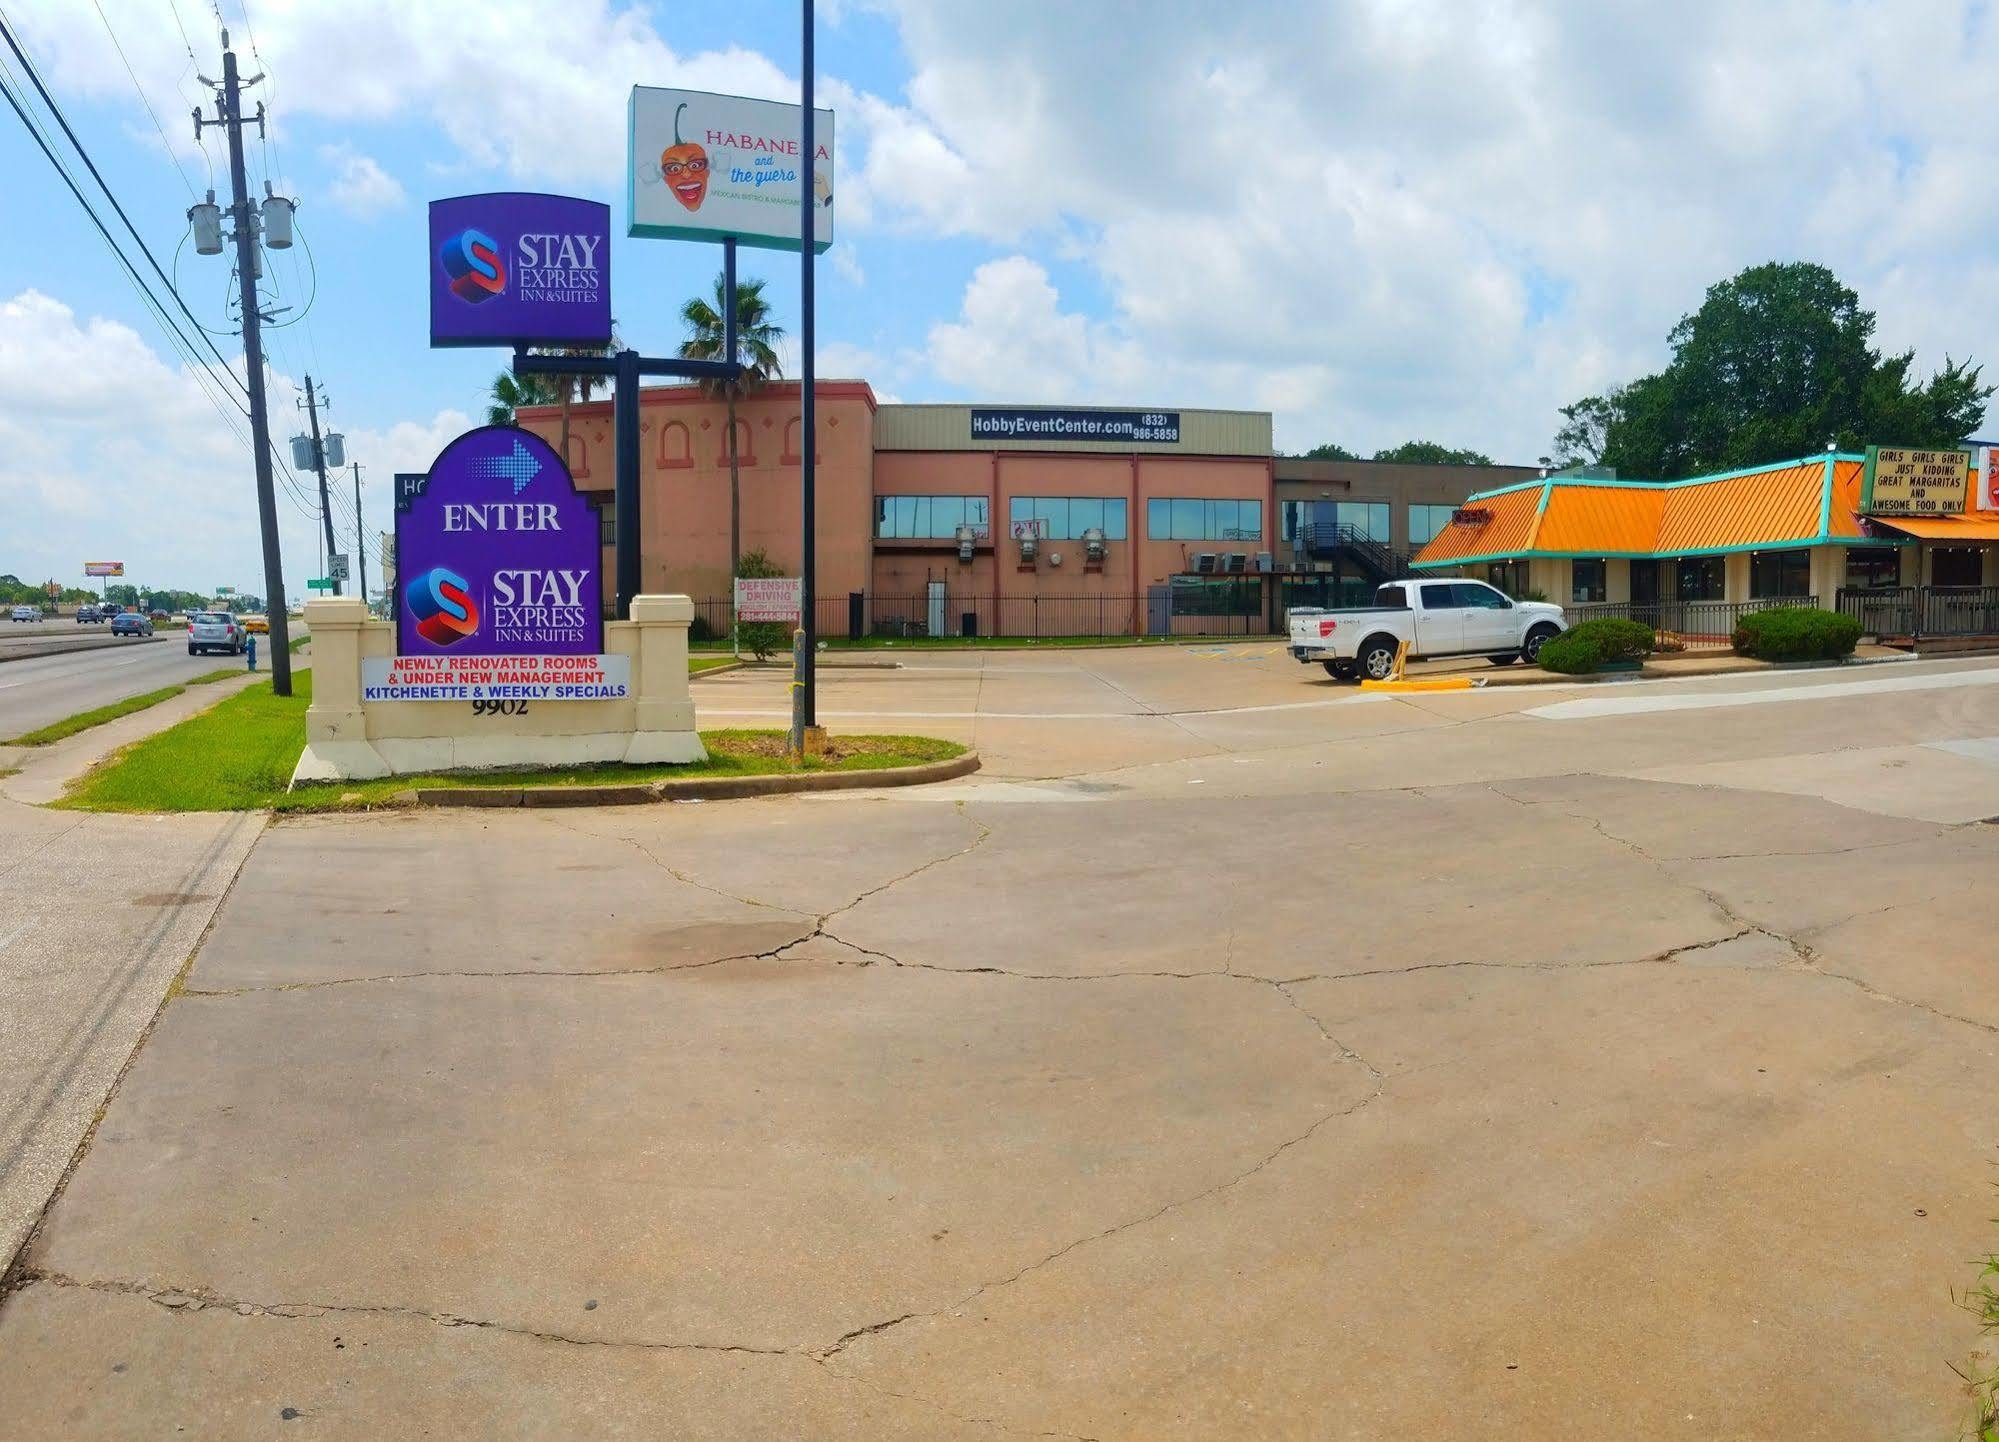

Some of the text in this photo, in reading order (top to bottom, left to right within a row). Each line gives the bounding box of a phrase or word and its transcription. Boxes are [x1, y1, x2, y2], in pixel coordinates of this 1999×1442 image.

[754, 156, 776, 166] and
[731, 168, 797, 188] the guero
[519, 233, 601, 269] STAY
[520, 269, 599, 289] EXPRESS
[521, 289, 598, 303] INN & SUITES
[973, 417, 1133, 436] HobbyEventCenter.com
[1142, 414, 1167, 426] (832)
[1133, 427, 1178, 440] 986-5858
[1879, 452, 1964, 464] GIRLS GIRLS GIRLS
[1895, 465, 1955, 476] JUST KIDDING
[1878, 476, 1960, 487] GREAT MARGARITAS
[1910, 489, 1925, 498] AND
[1872, 500, 1962, 511] AWESOME FOOD ONLY
[443, 503, 562, 532] ENTER
[1454, 511, 1486, 525] OPEN
[331, 568, 348, 579] 45
[493, 570, 590, 607] STAY
[739, 581, 799, 591] DEFENSIVE
[746, 592, 792, 601] DRIVING
[494, 608, 586, 628] EXPRESS
[495, 629, 585, 642] INN & SUITES
[393, 657, 598, 670] NEWLY RENOVATED ROOMS
[388, 671, 605, 684] & UNDER NEW MANAGEMENT
[365, 685, 626, 699] KITCHENETTE & WEEKLY SPECIALS
[472, 699, 529, 716] 9902
